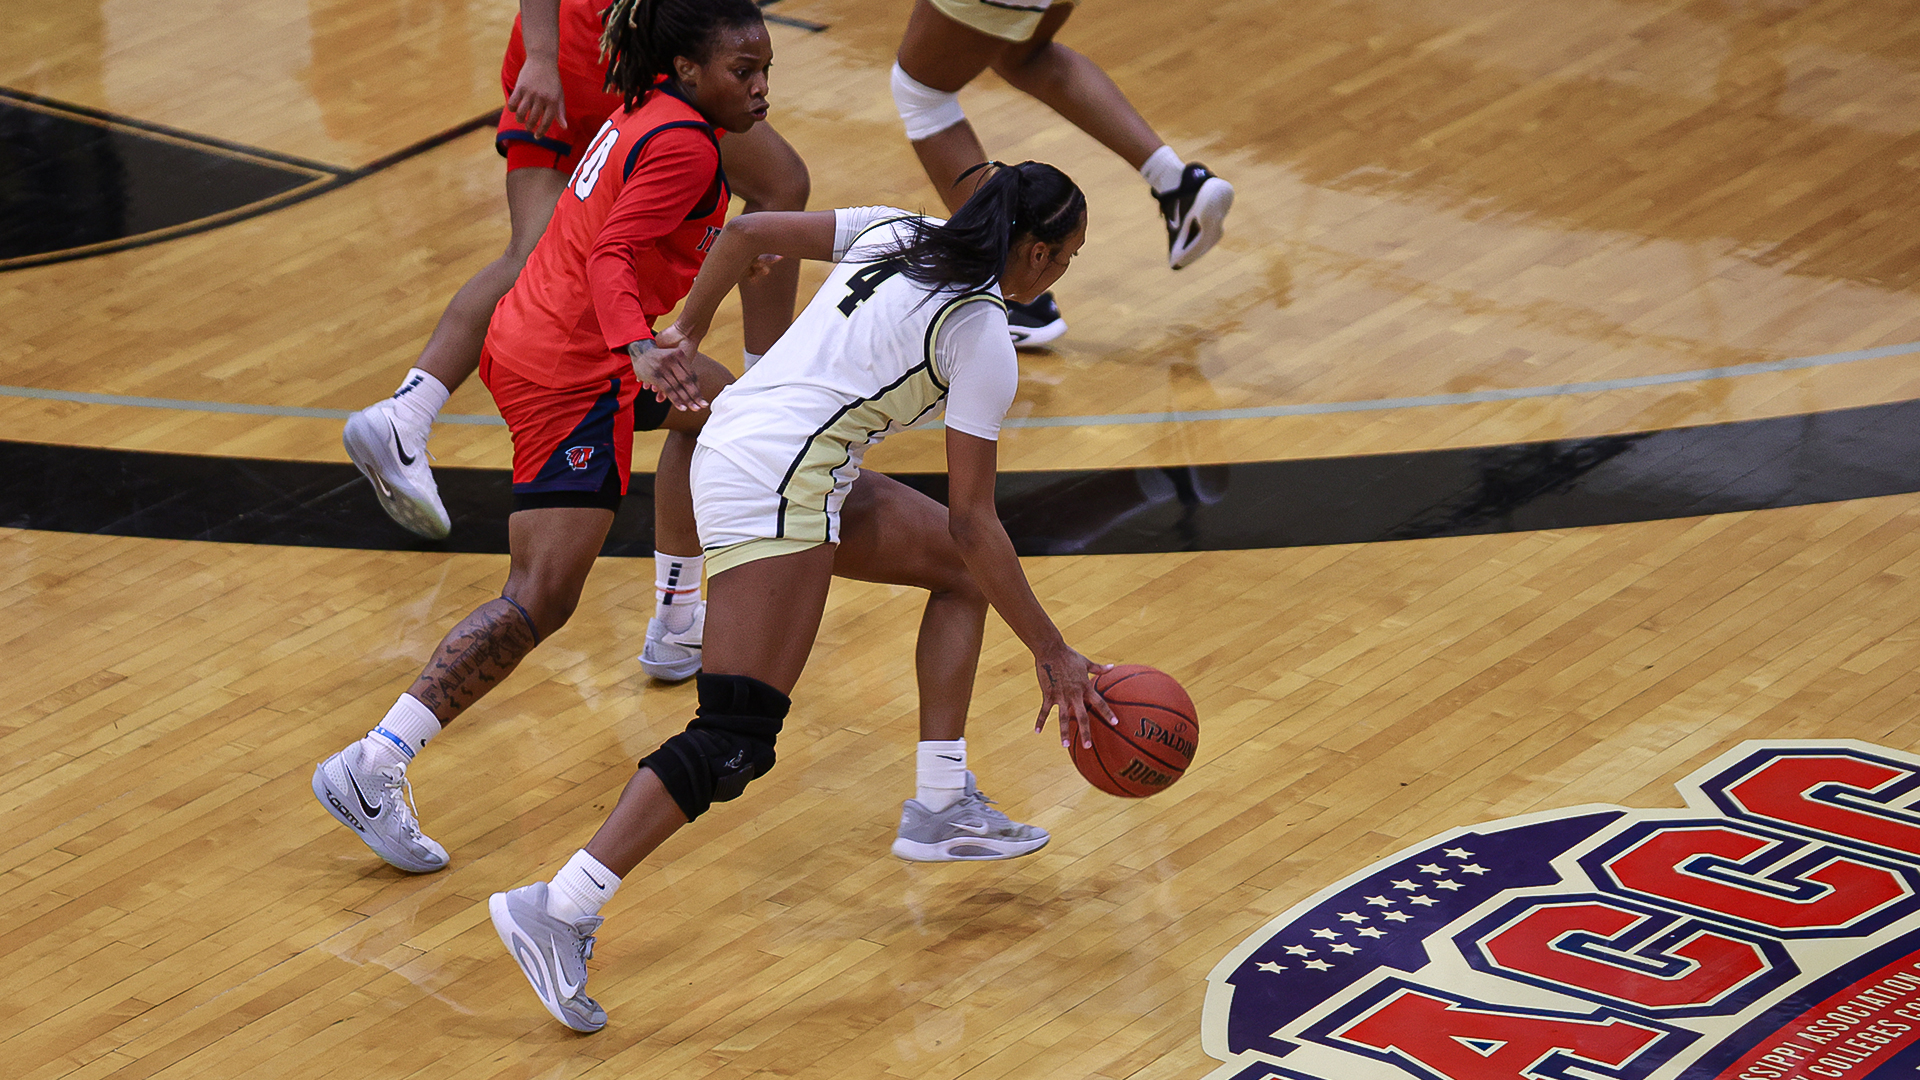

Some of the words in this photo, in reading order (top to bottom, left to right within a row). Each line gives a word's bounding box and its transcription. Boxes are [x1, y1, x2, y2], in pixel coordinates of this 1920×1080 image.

[836, 256, 912, 320] 4
[1134, 717, 1195, 759] SPALDIN
[1232, 745, 1920, 1080] ACCC
[1796, 971, 1920, 1045] ASSOCIATION
[1808, 1019, 1912, 1078] COLLEGES
